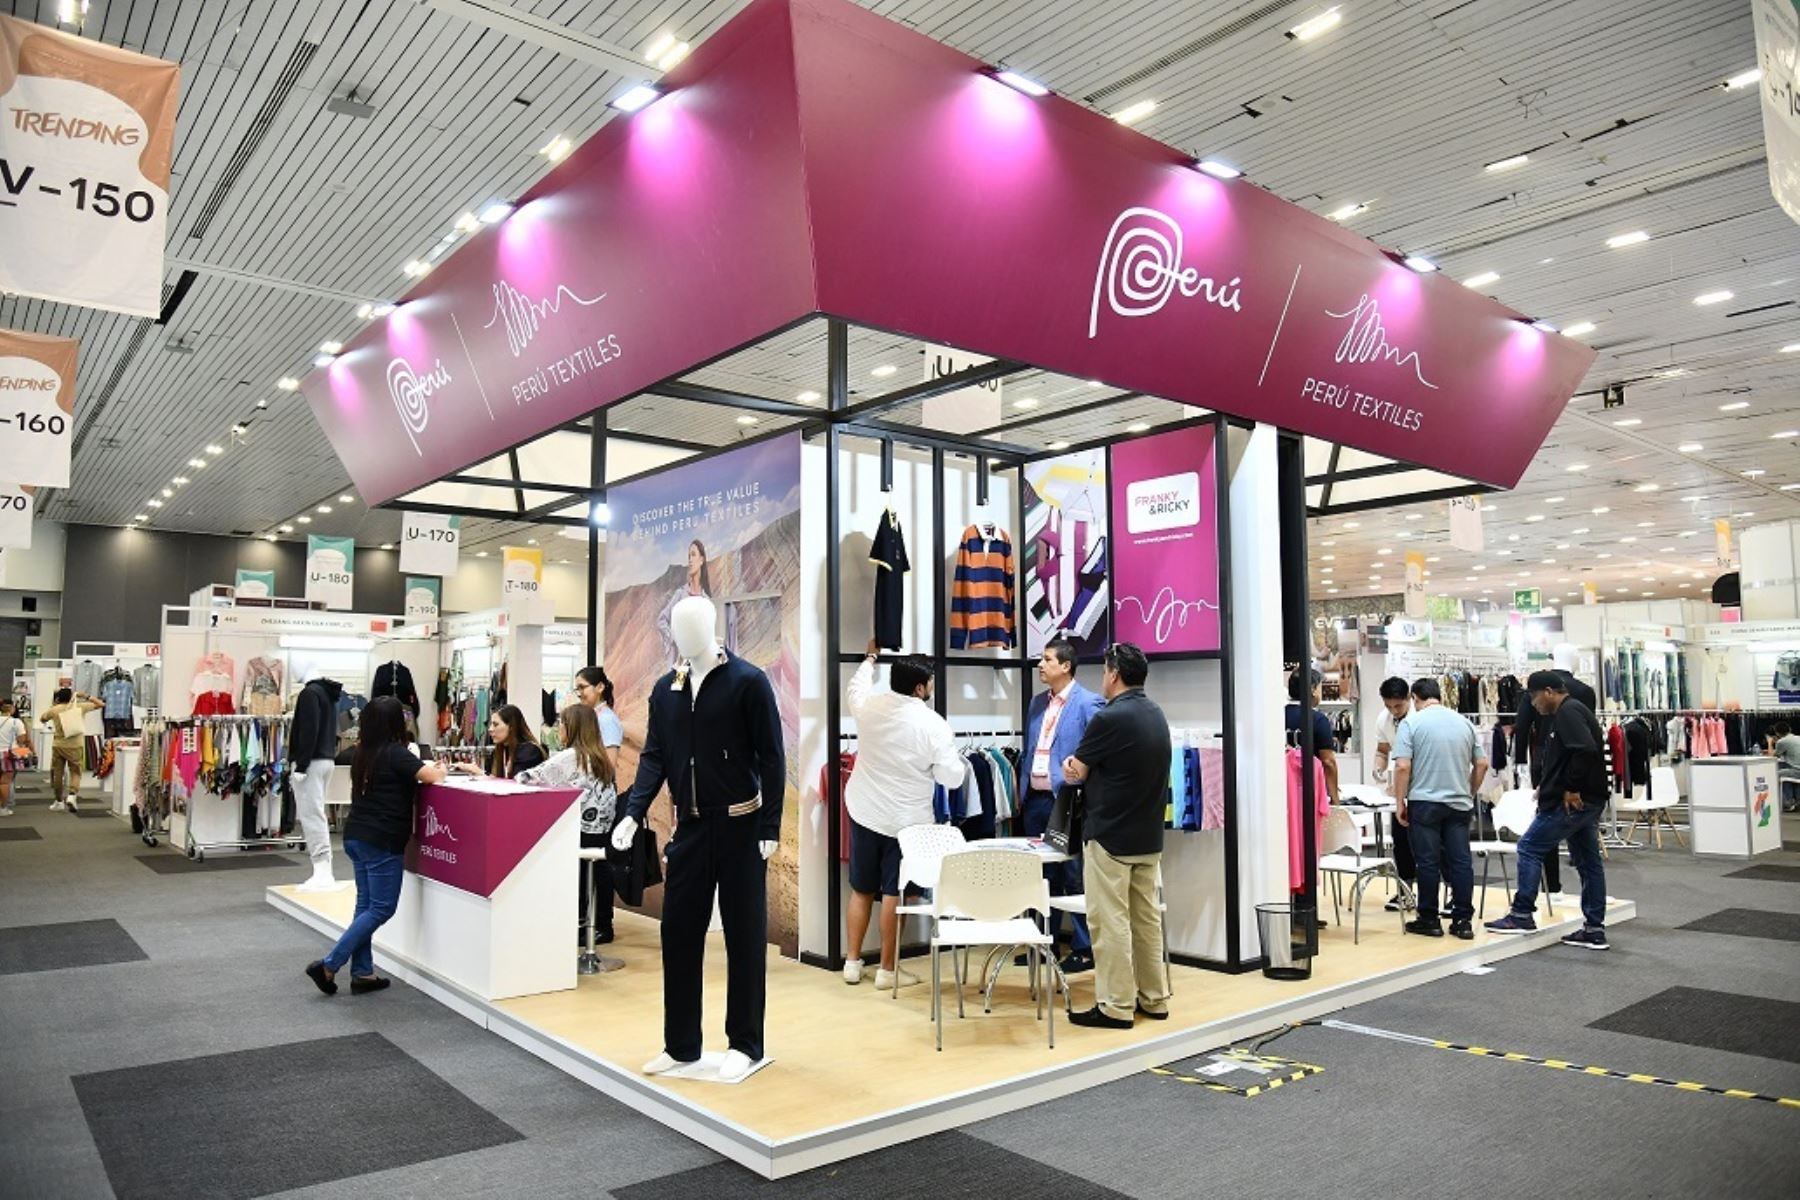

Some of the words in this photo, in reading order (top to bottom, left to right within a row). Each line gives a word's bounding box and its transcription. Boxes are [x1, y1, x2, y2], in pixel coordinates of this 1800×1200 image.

[10, 107, 140, 145] TRENDING
[0, 158, 155, 222] V-150
[1089, 206, 1242, 338] Perú
[512, 367, 549, 406] PERÚ
[547, 333, 623, 387] TEXTILES
[386, 357, 452, 458] Perú
[1302, 377, 1350, 408] PERÚ
[1353, 392, 1424, 432] TEXTILES
[632, 504, 674, 525] DISCOVER
[677, 499, 695, 513] THE
[697, 490, 723, 509] TRUE
[726, 481, 760, 501] VALUE
[703, 501, 760, 528] TEXTILES
[1135, 490, 1179, 507] FRANKY
[1149, 499, 1190, 516] &RICKY
[408, 526, 456, 543] U-170
[311, 571, 350, 585] U-180
